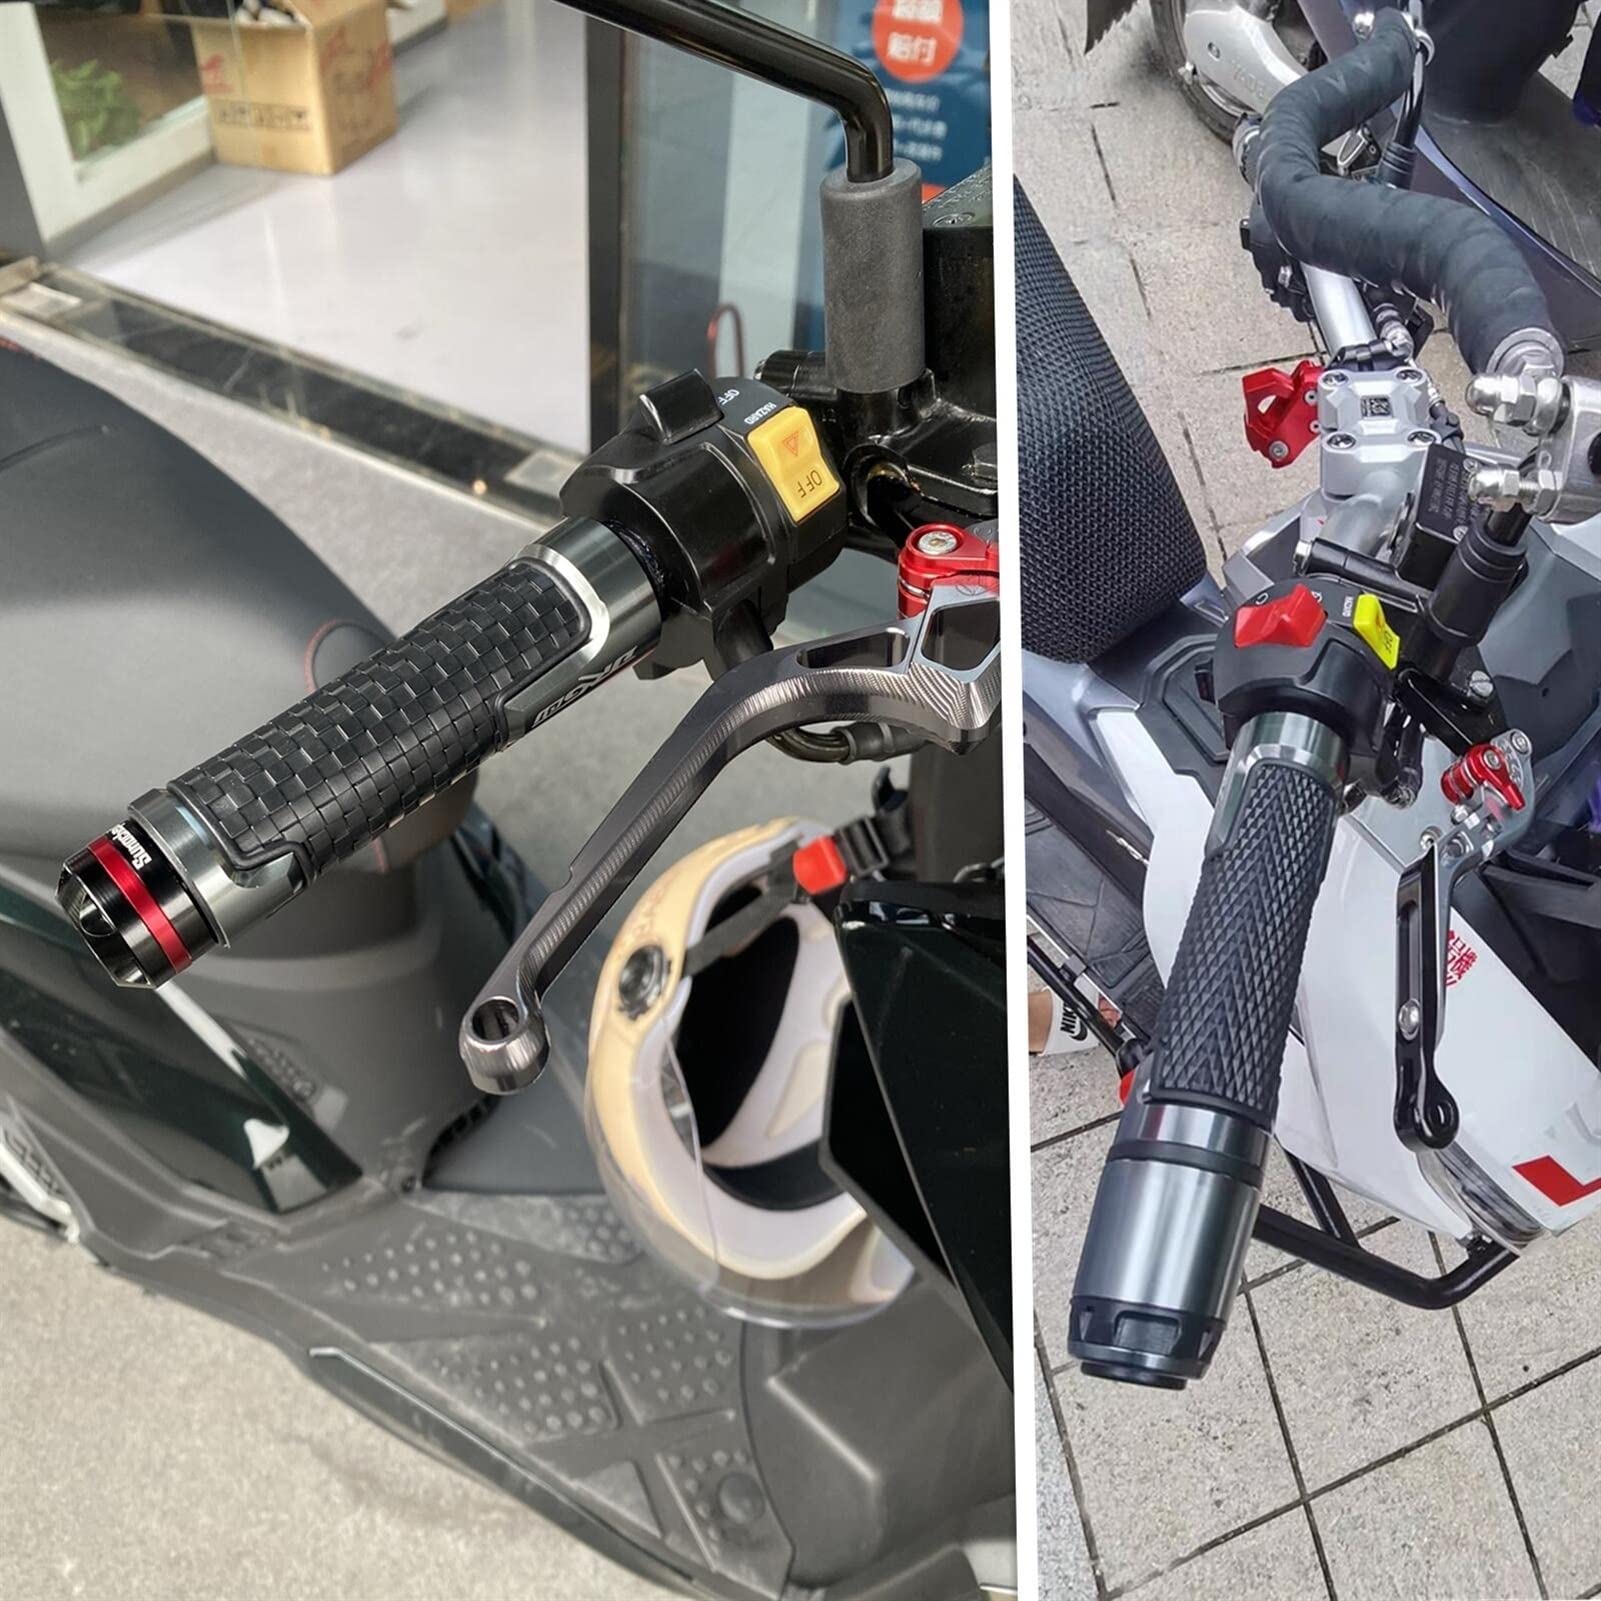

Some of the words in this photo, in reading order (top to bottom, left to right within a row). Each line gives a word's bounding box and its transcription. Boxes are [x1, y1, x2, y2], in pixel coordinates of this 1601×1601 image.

[718, 388, 740, 405] OFF
[743, 401, 777, 425] HAZARD
[797, 469, 823, 499] OFF
